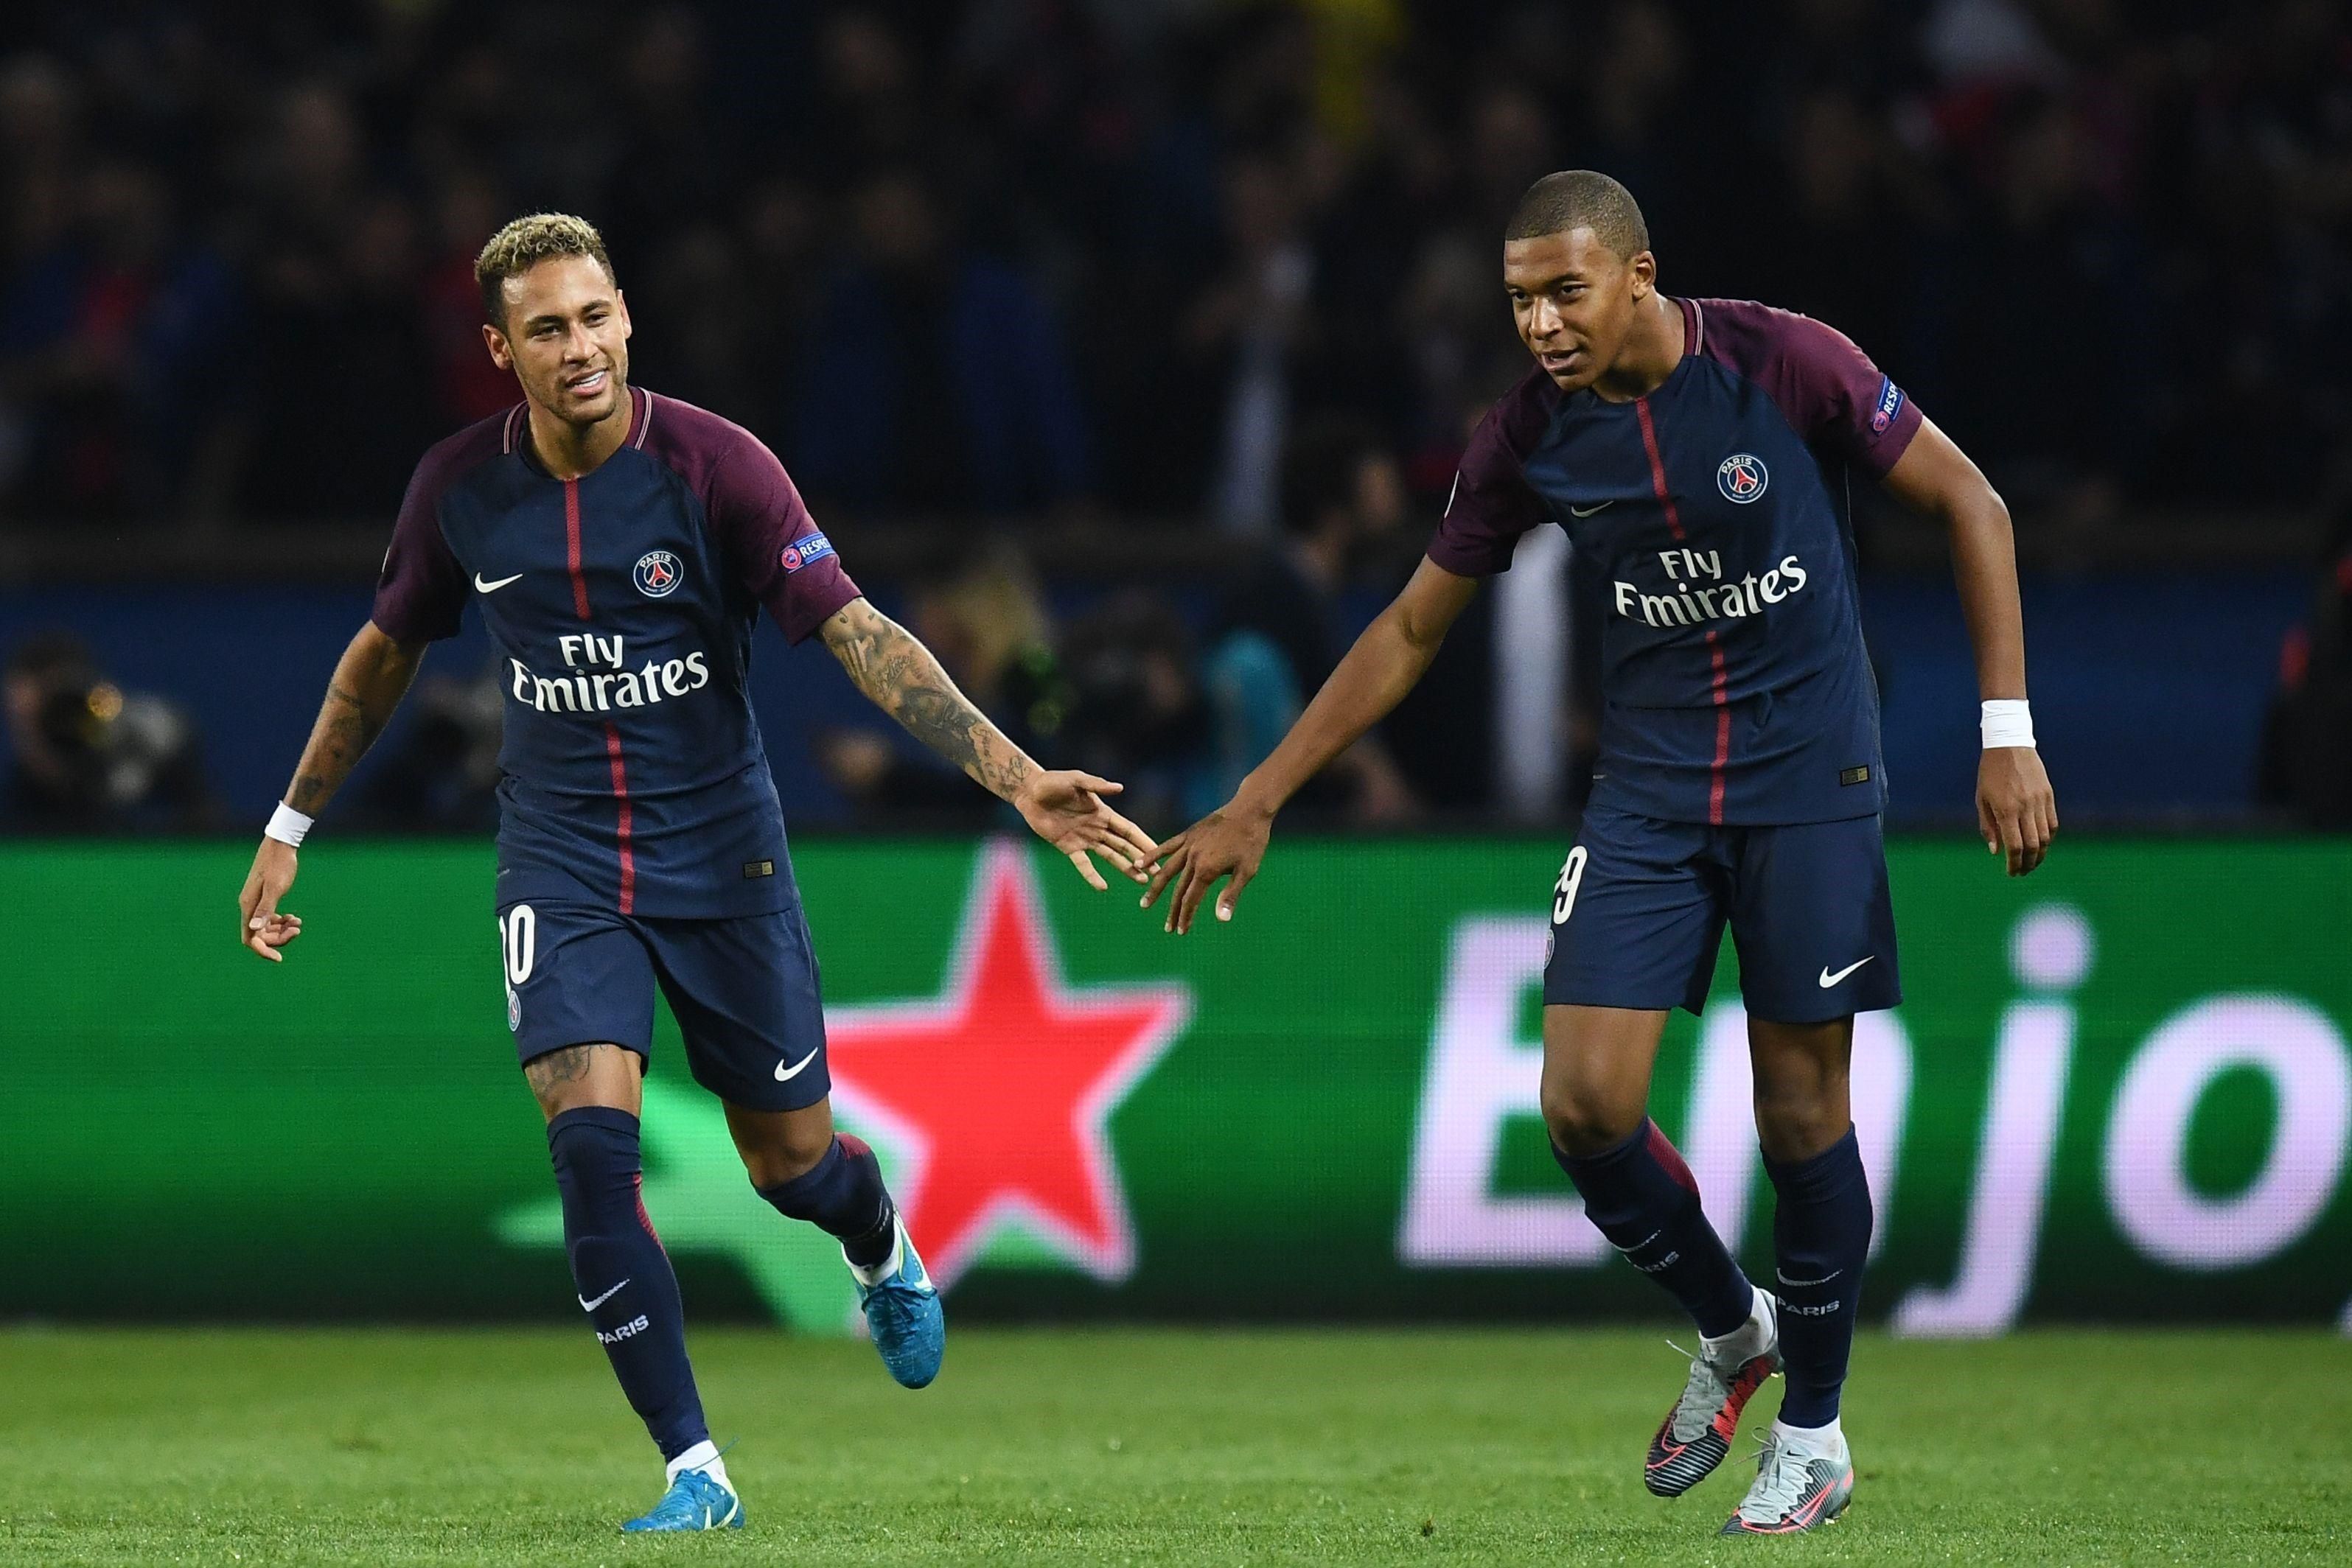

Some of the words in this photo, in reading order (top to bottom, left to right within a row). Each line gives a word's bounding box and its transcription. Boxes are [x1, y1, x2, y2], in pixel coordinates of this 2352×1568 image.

[1883, 380, 1899, 415] RESP
[1721, 457, 1752, 474] PARIS
[639, 553, 671, 568] PARIS
[1658, 549, 1722, 580] Fly
[1613, 555, 1807, 627] Emirates
[559, 634, 623, 669] Fly
[510, 652, 708, 713] Emirates
[1397, 902, 2352, 1339] Enjo
[1777, 1295, 1840, 1316] PARIS
[596, 1315, 649, 1345] PARIS
